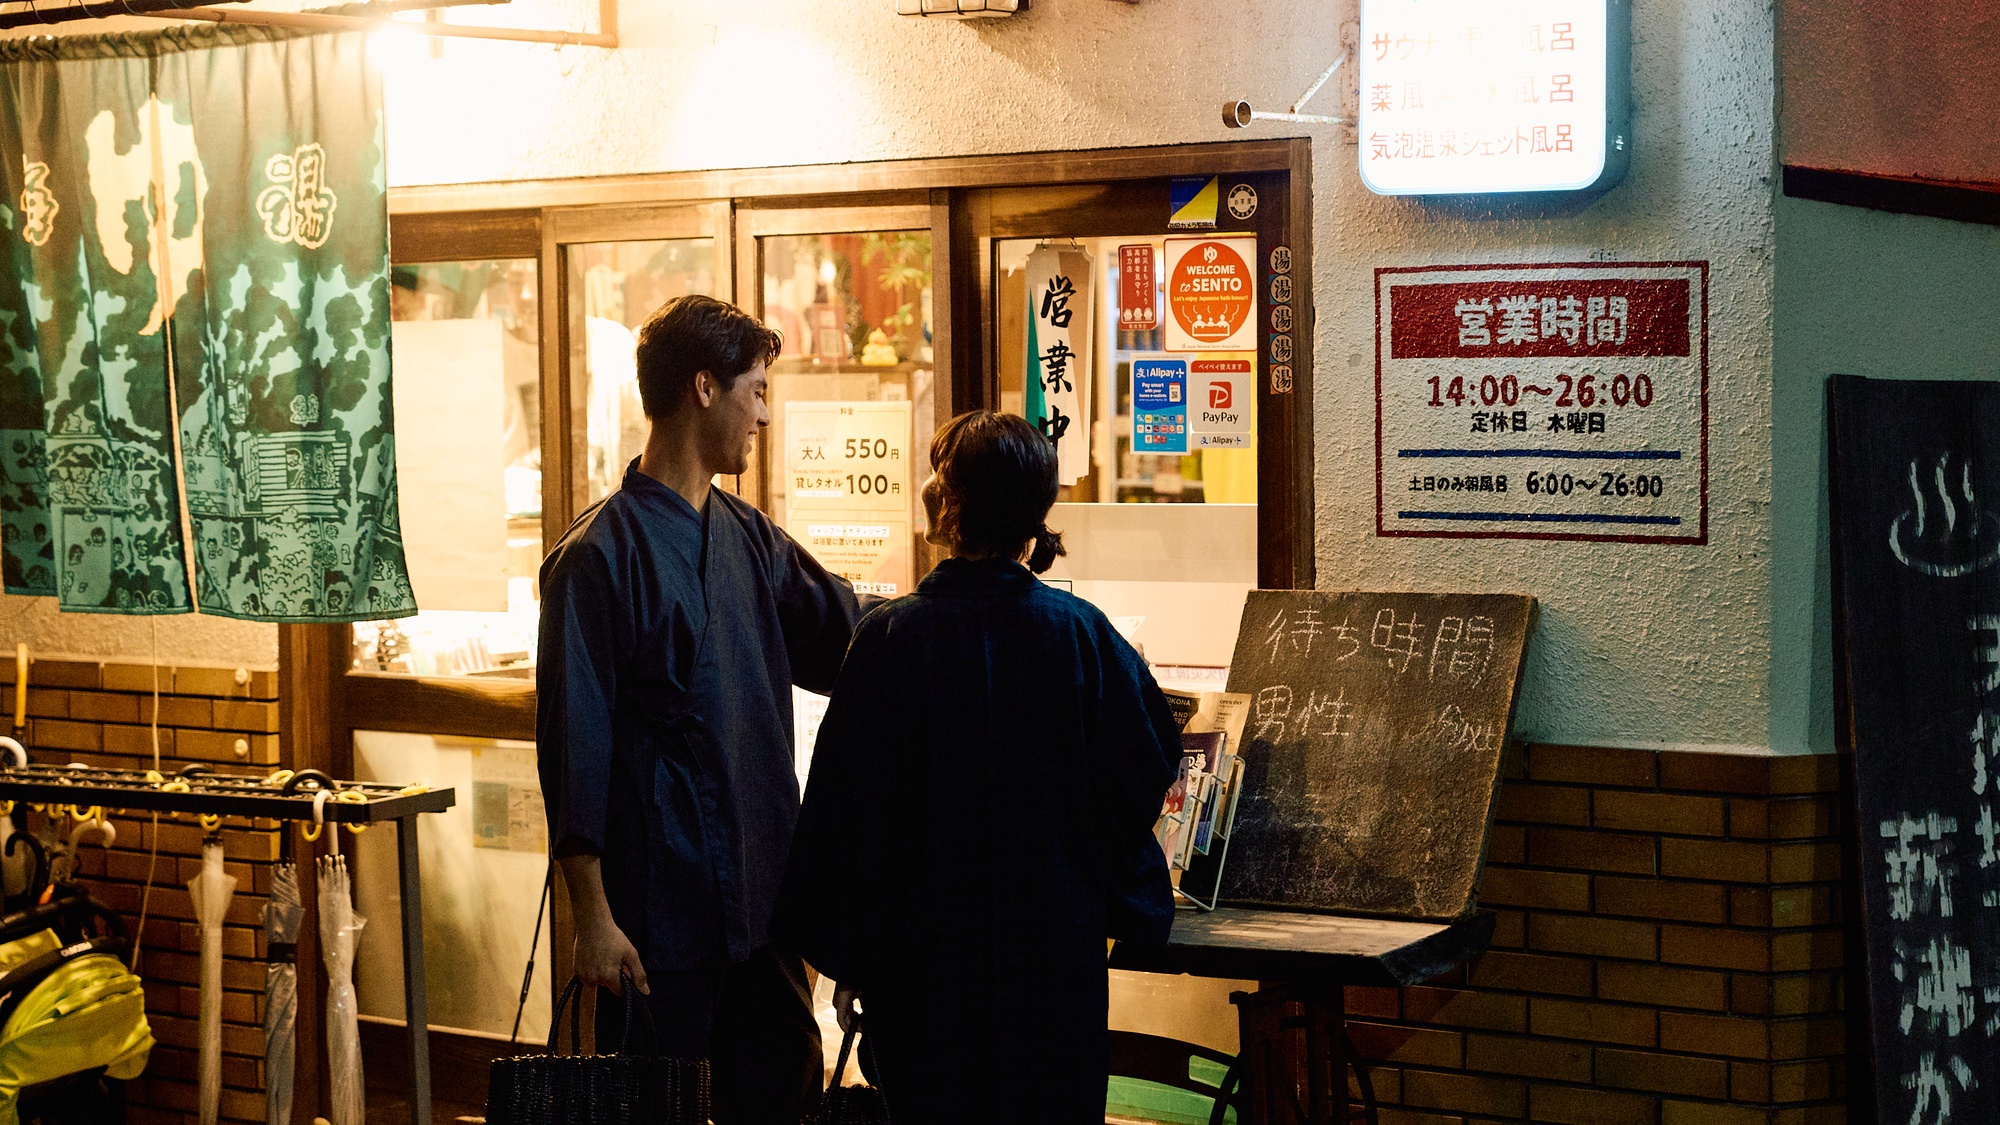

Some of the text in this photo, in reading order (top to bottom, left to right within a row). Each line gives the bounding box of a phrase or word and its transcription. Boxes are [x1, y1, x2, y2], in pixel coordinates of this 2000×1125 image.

[1372, 32, 1440, 61] サウナ
[1369, 124, 1574, 160] 気泡温泉ジェット風呂
[1186, 265, 1236, 275] WELCOME
[1180, 277, 1242, 292] to SENTO
[1274, 249, 1292, 389] 湯 湯 湯 湯 湯
[1454, 295, 1629, 348] 営業時間
[1038, 274, 1076, 448] 営業中
[1427, 373, 1654, 408] 14:00～26:00
[1203, 411, 1239, 424] PayPay
[1470, 410, 1528, 433] 定休日
[802, 445, 825, 460] 大人
[795, 477, 843, 488] 貸しタオル
[1408, 471, 1663, 498] 土日のみ朝風呂 6:00～26:00
[1264, 605, 1494, 689] 待ち時間
[1166, 696, 1191, 706] OKONA
[1254, 685, 1354, 745] 男性
